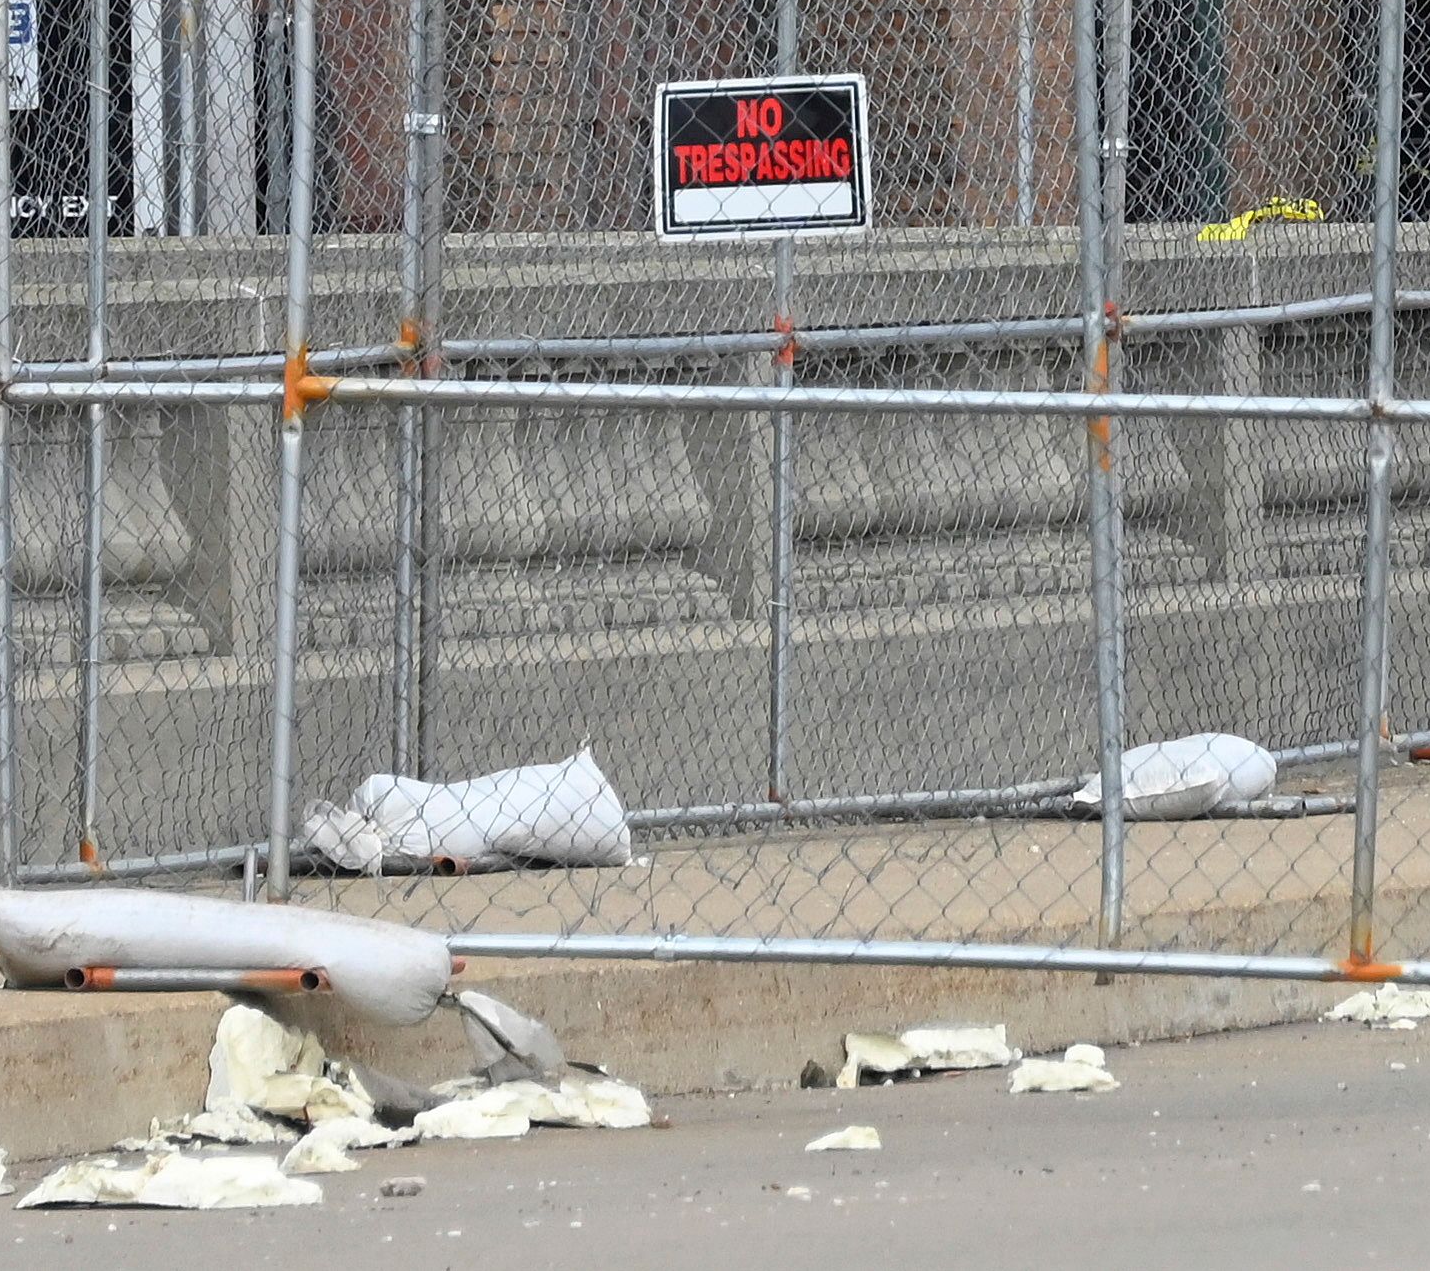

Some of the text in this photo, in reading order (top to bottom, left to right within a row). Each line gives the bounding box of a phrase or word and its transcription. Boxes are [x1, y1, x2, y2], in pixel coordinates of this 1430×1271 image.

[737, 98, 783, 138] NO
[674, 138, 851, 184] TRESPASSING
[63, 195, 119, 218] EXT
